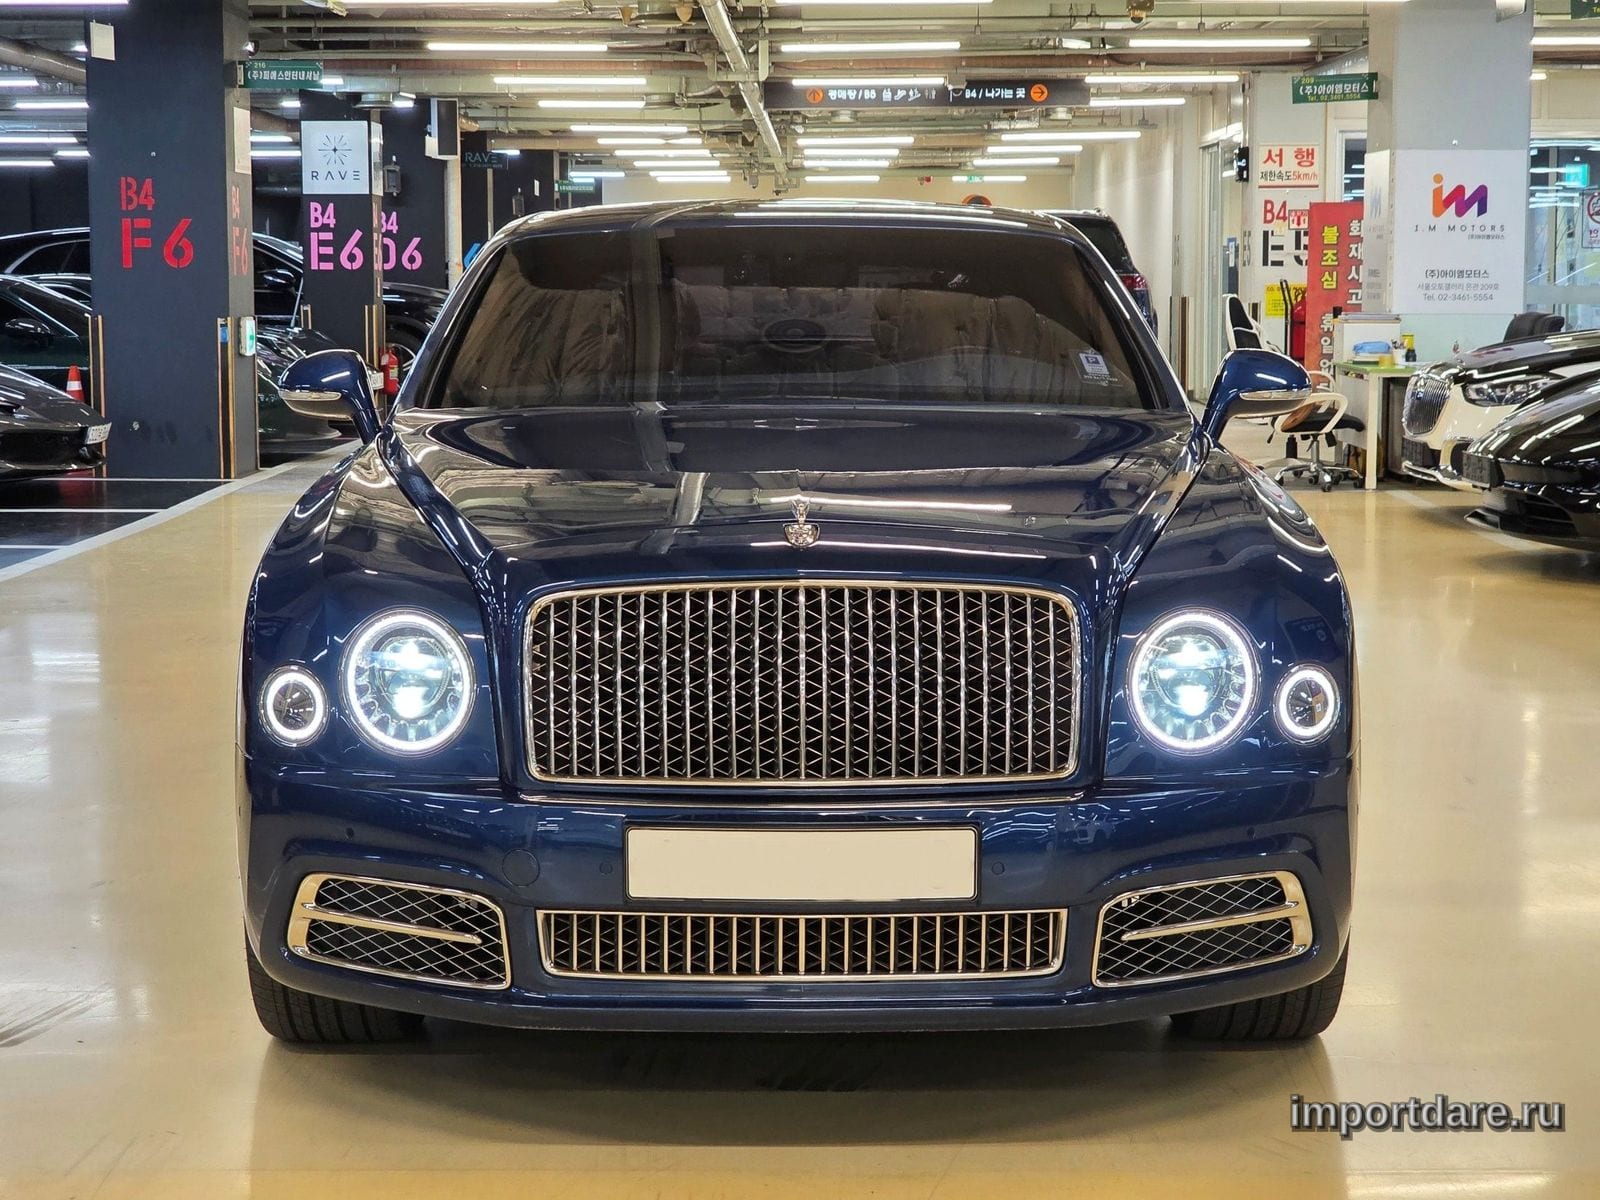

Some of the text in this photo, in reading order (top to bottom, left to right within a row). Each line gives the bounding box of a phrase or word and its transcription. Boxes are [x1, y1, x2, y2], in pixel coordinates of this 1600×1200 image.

[985, 87, 1014, 99] 나가는
[310, 170, 361, 181] RAVE
[120, 176, 156, 212] B4
[310, 201, 337, 228] B4
[1262, 199, 1288, 225] B4
[1447, 224, 1505, 233] MOTORS
[1320, 225, 1340, 290] 불조심
[1425, 268, 1490, 279] (주)아이엠모터스
